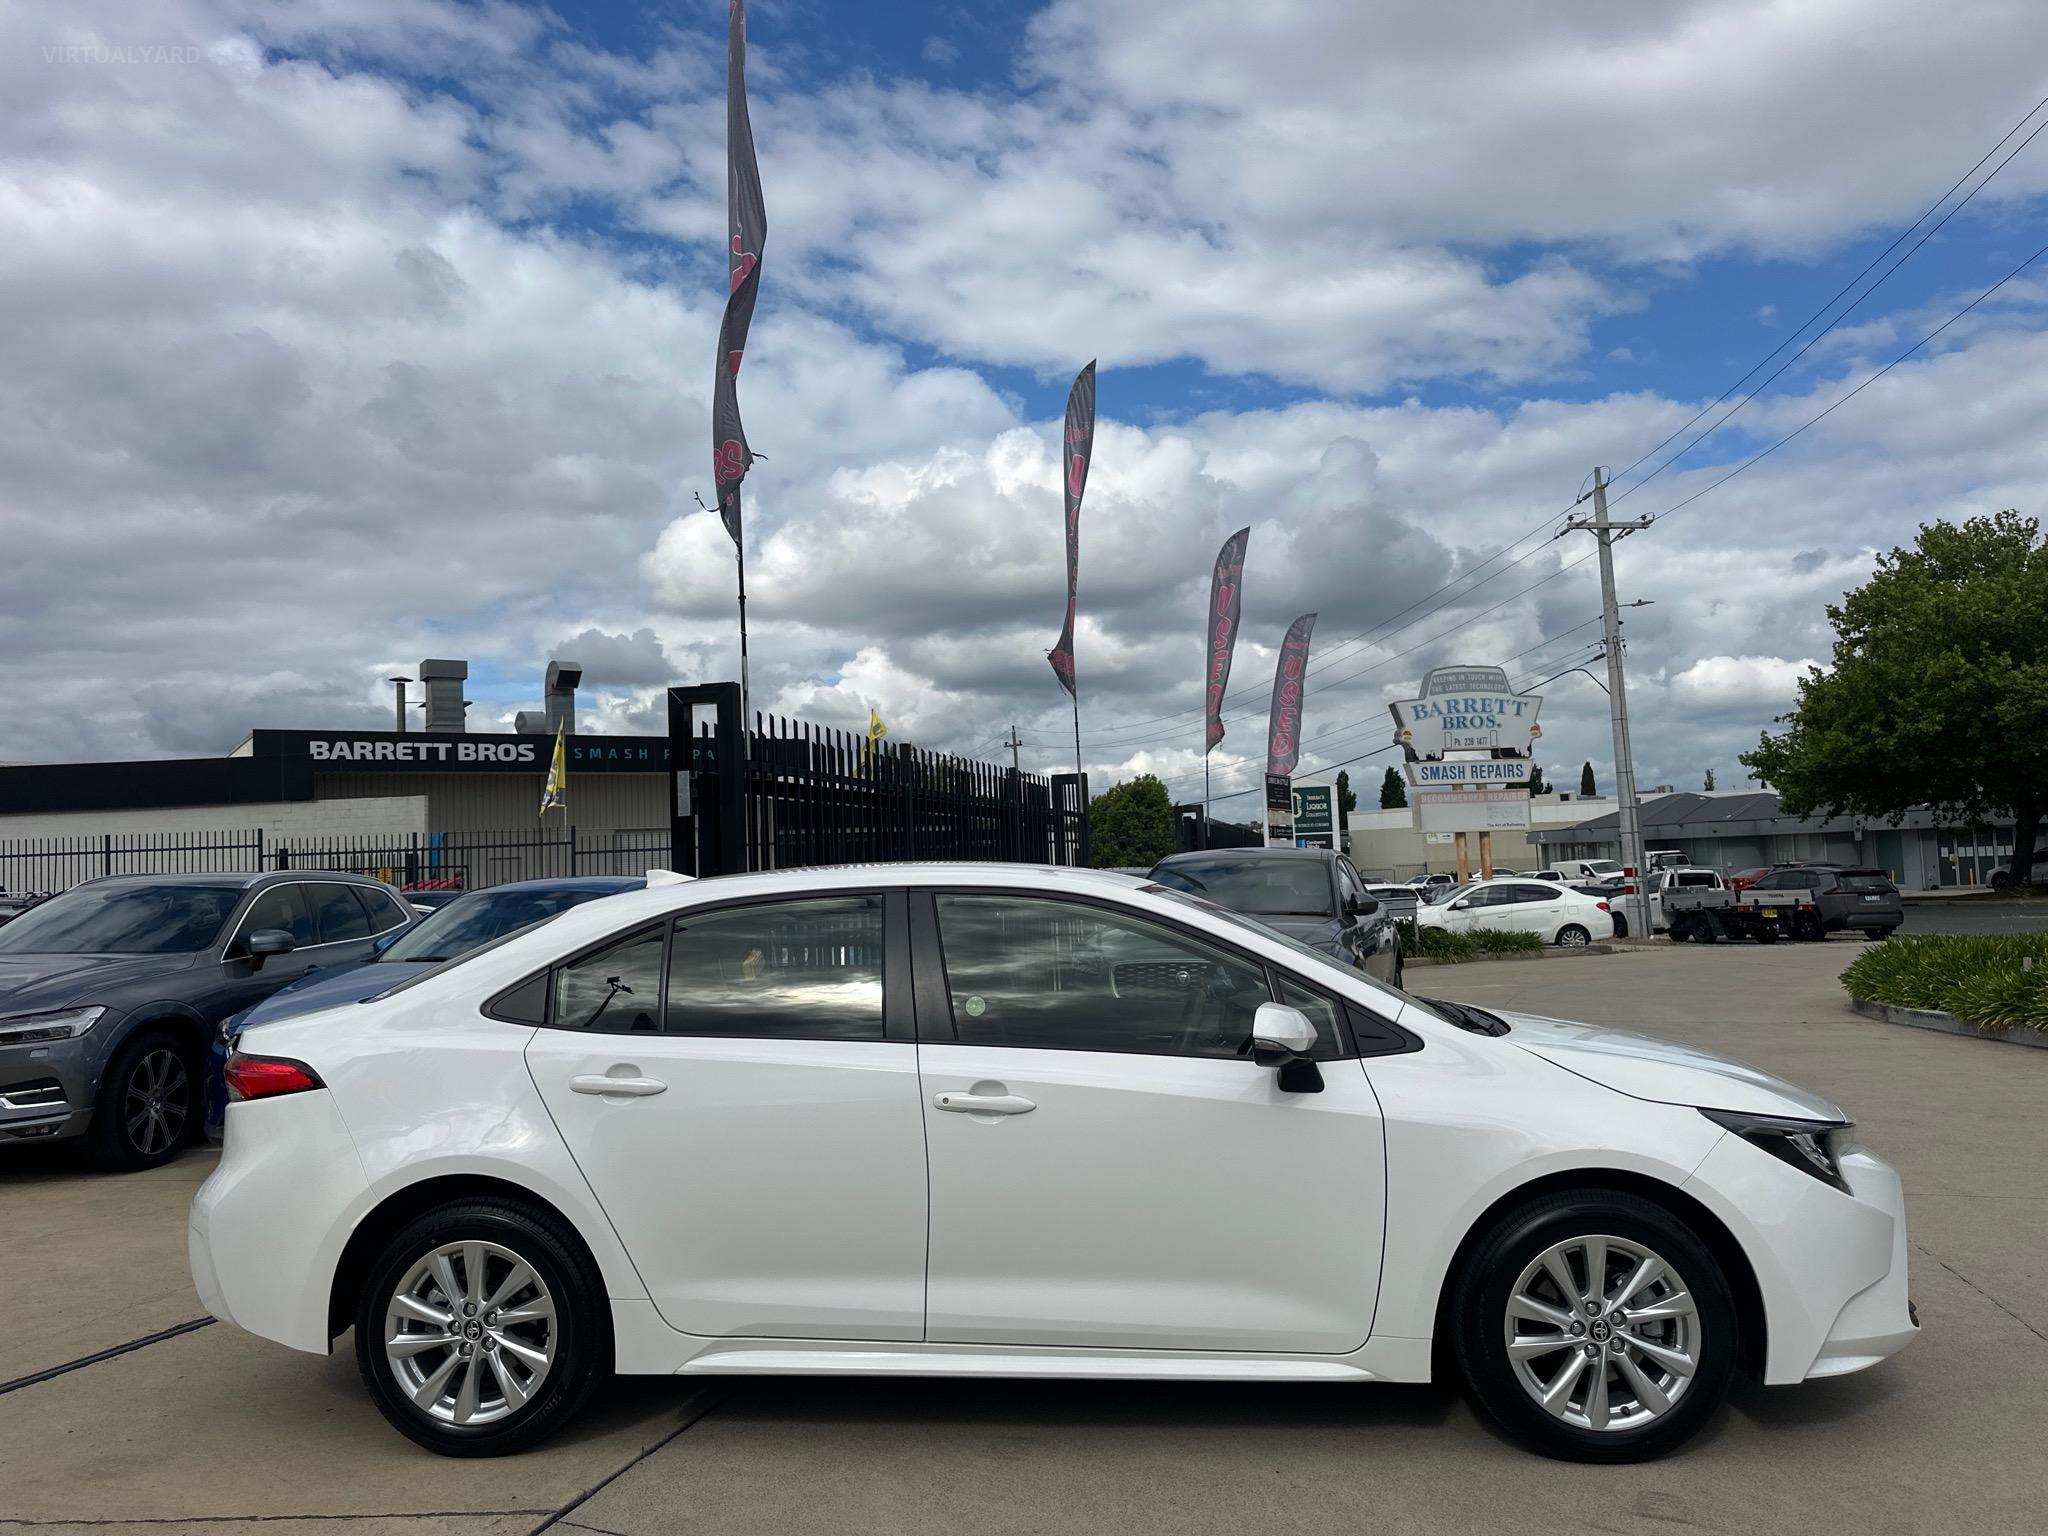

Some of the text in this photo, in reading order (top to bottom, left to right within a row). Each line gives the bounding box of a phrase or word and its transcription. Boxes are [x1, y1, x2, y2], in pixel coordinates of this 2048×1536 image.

[1272, 655, 1304, 757] USED
[1411, 698, 1528, 720] BARRETT
[1442, 714, 1502, 730] BROS.
[309, 741, 452, 761] BARRETT
[457, 743, 535, 762] BROS
[574, 748, 648, 759] SMASH
[1421, 764, 1524, 781] SMASH REPAIRS
[1422, 792, 1528, 803] RECOMMENDED REPAIRER
